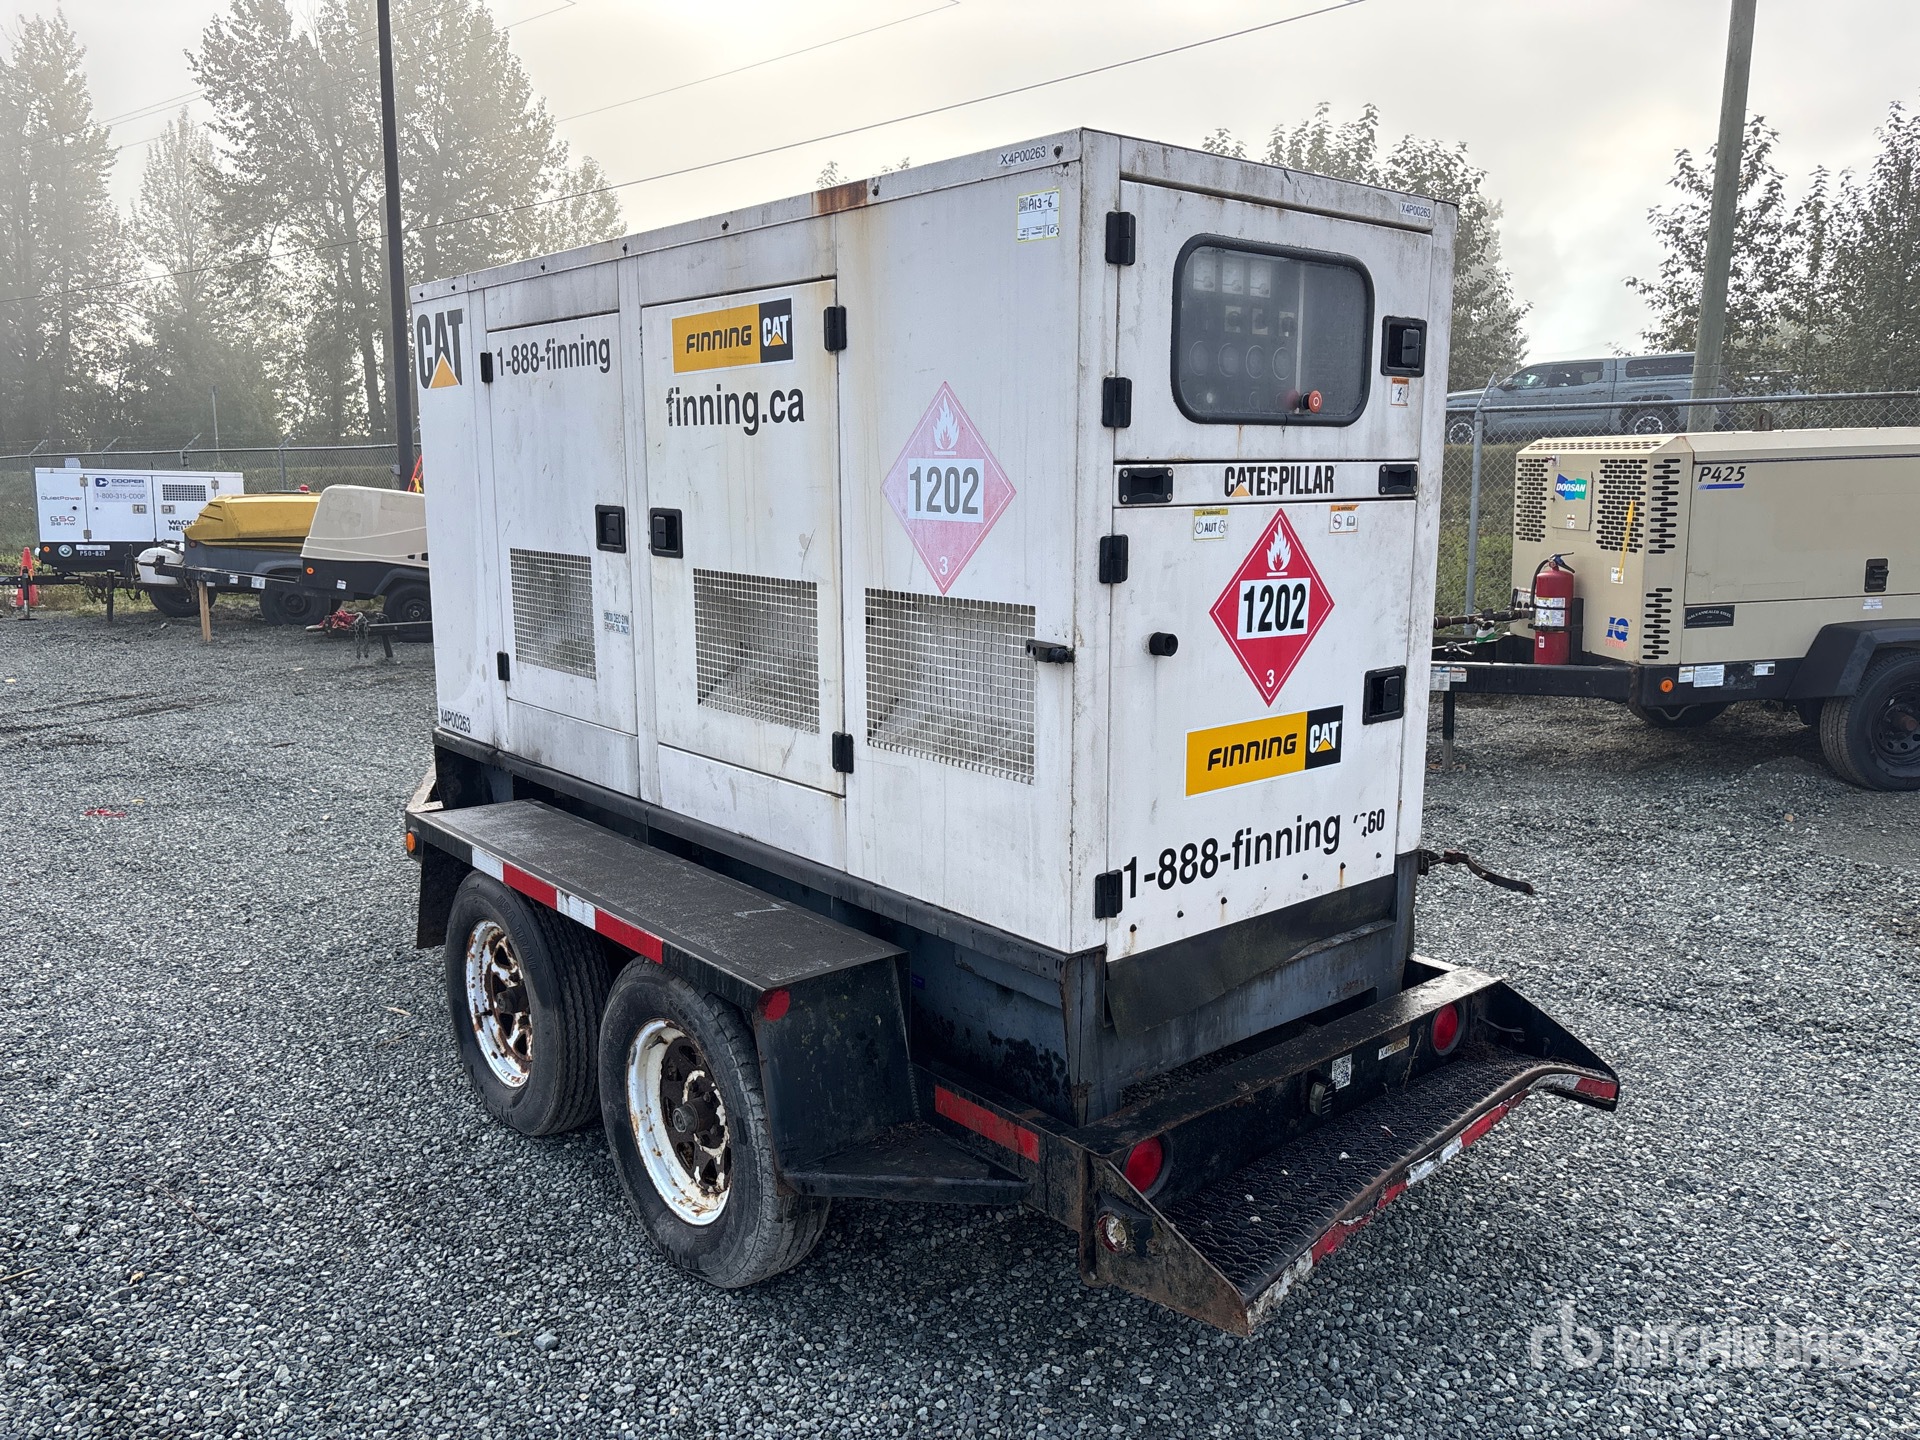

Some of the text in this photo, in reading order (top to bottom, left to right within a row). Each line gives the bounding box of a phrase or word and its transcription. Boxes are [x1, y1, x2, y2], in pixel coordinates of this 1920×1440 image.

[1000, 145, 1046, 165] X4P00263
[1401, 202, 1430, 218] X4P00263
[416, 309, 462, 388] CAT
[686, 315, 790, 354] FINNING CAT
[497, 334, 610, 377] 1-888-finning
[666, 384, 804, 436] finning.ca
[1224, 465, 1334, 497] CATERPILLAR
[1555, 482, 1587, 493] DOOSAN
[1698, 466, 1746, 482] P425
[96, 492, 146, 500] 1-800-315-COOP
[909, 466, 979, 514] 1202
[940, 556, 949, 576] 3
[1243, 583, 1306, 633] 1202
[1606, 617, 1629, 642] IQ
[1266, 669, 1275, 687] 3
[440, 708, 470, 733] X4P00263
[1207, 721, 1340, 771] FINNING CAT
[1123, 814, 1341, 899] 1-888-finning
